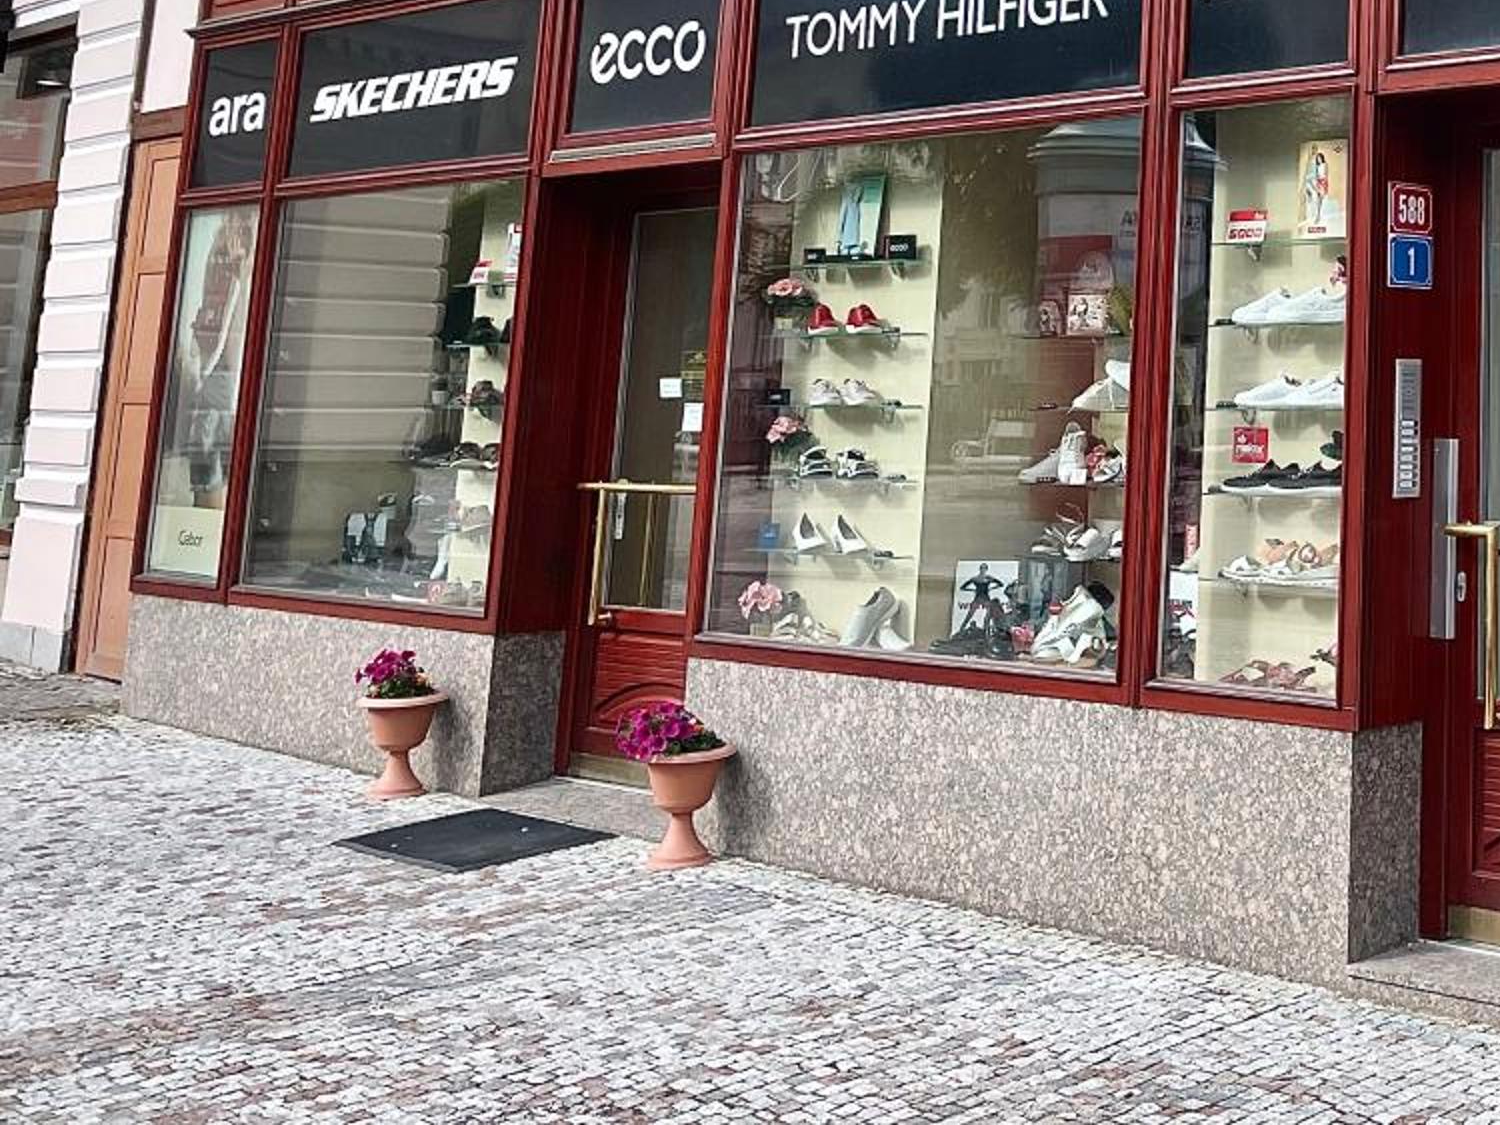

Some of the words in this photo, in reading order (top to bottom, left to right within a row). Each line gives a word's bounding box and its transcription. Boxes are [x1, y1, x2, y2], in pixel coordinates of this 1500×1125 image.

[590, 20, 706, 84] ecco
[310, 56, 518, 123] SKECHERS
[208, 91, 266, 137] ara
[1398, 194, 1425, 225] 588
[1407, 246, 1415, 276] 1
